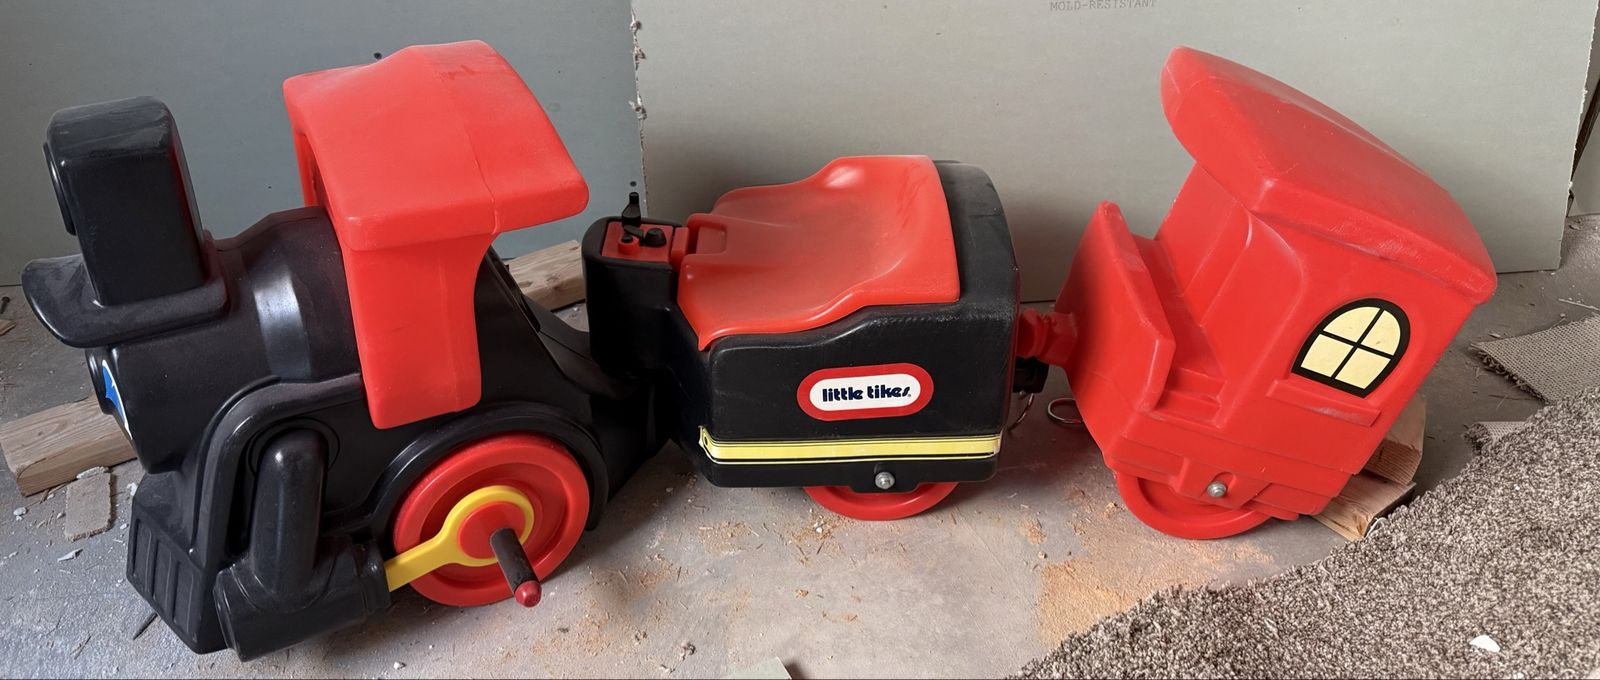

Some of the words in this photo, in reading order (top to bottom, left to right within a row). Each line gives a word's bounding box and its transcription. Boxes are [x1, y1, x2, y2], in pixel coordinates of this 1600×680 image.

[1050, 0, 1156, 11] MOLD-RESISTANT
[822, 387, 864, 402] little
[867, 384, 911, 399] tikes
